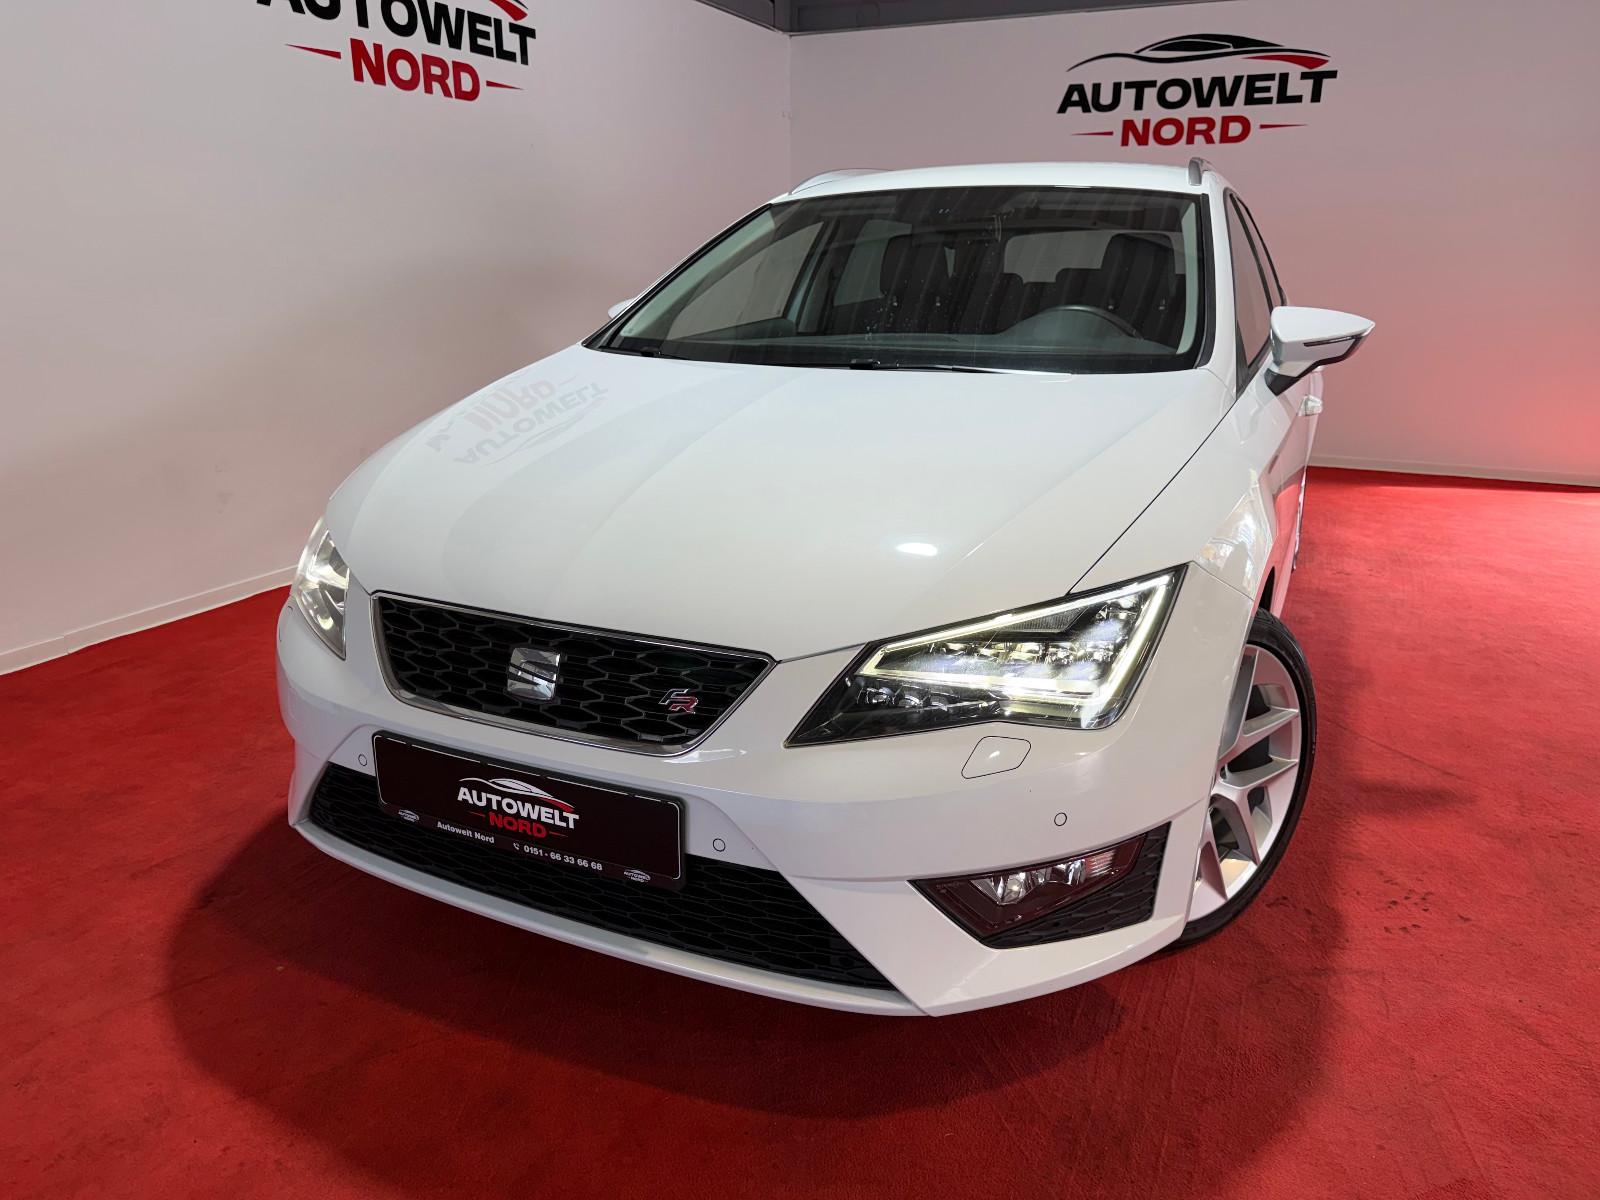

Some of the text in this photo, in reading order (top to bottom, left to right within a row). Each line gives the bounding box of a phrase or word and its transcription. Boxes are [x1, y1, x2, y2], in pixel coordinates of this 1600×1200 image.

[350, 38, 481, 102] NORD
[1056, 70, 1338, 114] AUTOWELT
[1120, 115, 1252, 147] NORD
[658, 688, 699, 715] FR
[457, 786, 580, 829] AUTOWELT
[437, 821, 495, 844] Autowelt Nord
[488, 812, 548, 839] NORD
[523, 845, 543, 857] 0151
[549, 851, 562, 861] 66
[563, 855, 575, 864] 33
[577, 858, 589, 868] 66
